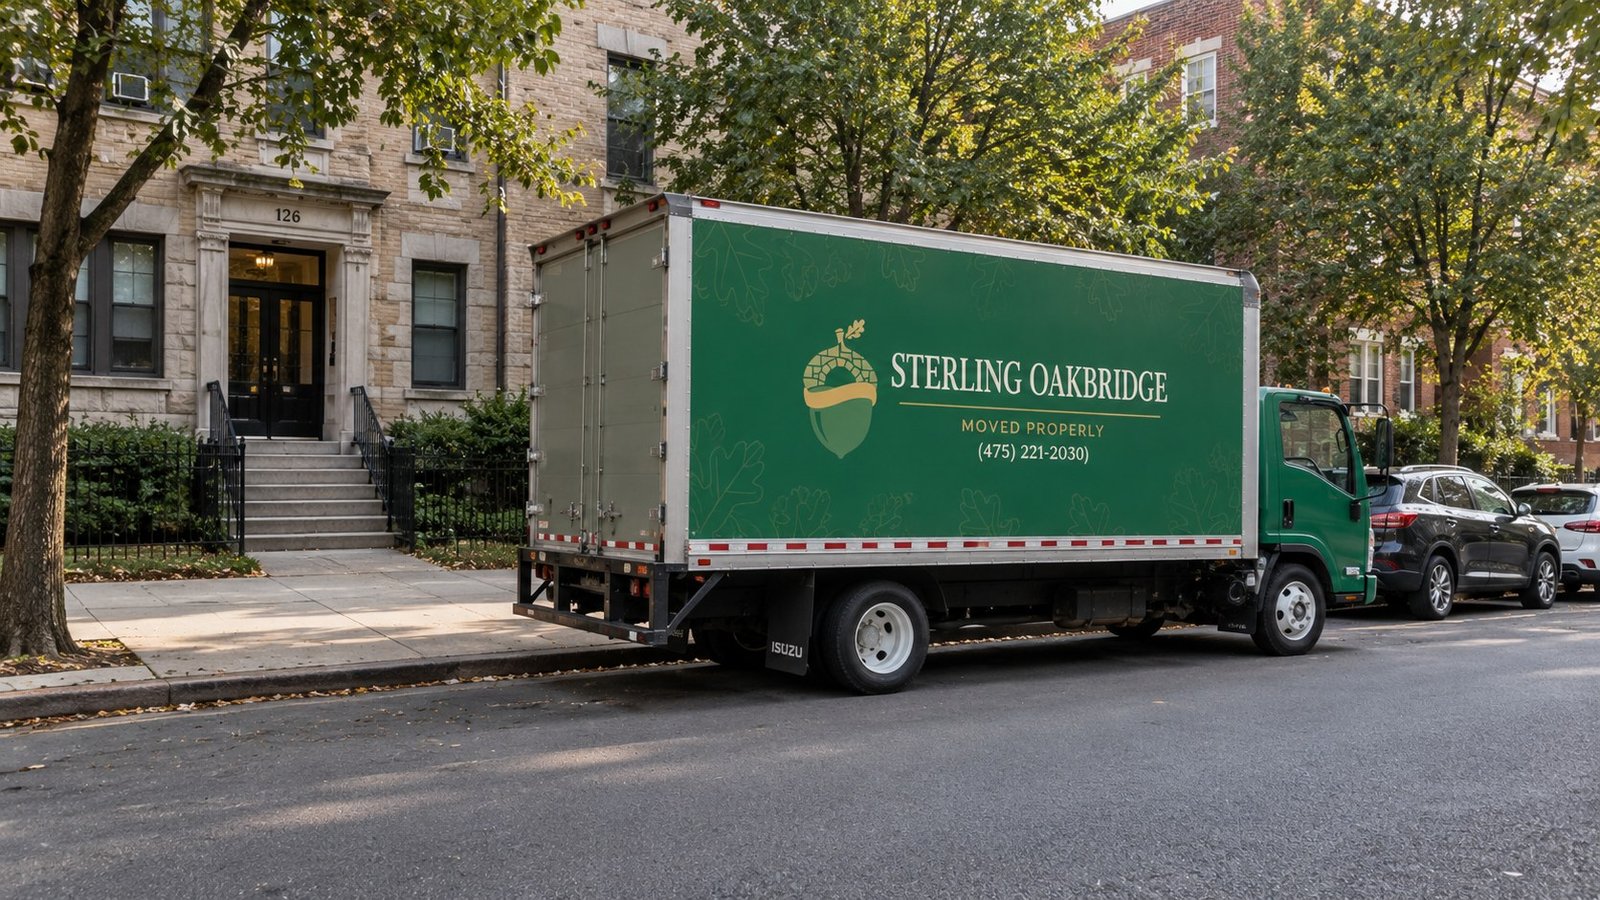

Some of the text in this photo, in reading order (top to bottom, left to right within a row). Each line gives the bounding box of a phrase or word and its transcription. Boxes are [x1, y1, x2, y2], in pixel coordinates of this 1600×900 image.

[275, 208, 301, 223] 126
[891, 352, 1168, 403] STERLING OAKBRIDGE
[961, 419, 1105, 438] MOVED PROPERLY
[978, 442, 1089, 465] (475) 221-2030)
[771, 641, 803, 659] ISUZU
